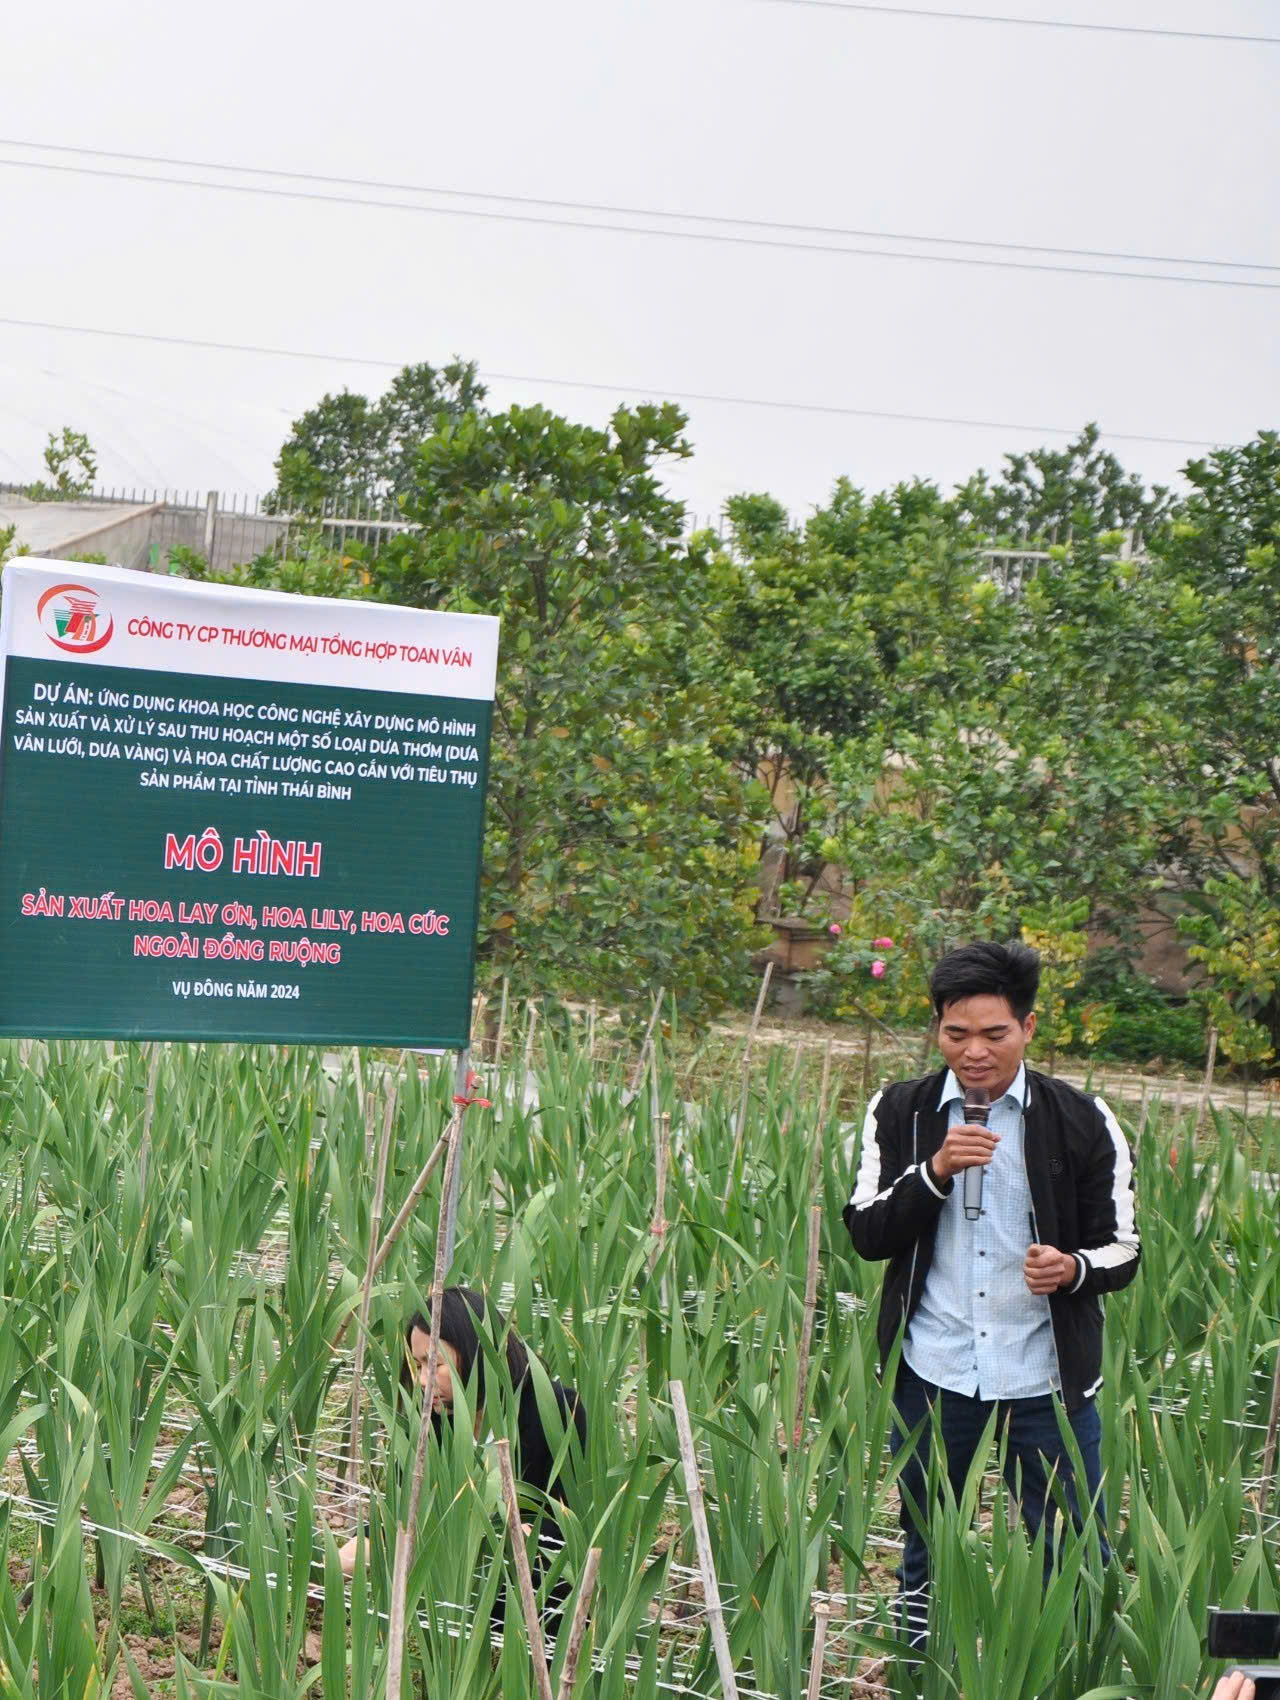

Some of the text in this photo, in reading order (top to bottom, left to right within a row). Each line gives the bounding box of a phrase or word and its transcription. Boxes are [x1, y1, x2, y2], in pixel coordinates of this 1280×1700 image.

[128, 616, 472, 668] CÔNG TY CP THƯƠNG MẠI TỔNG HỢP TOAN VÂN
[16, 706, 478, 762] SẢN XUẤT VÀ XỬ LÝ SAU THU HOẠCH MỘT SỐ LOẠI DƯA THƠM (DƯA
[34, 682, 476, 737] DỰ ÁN: ỨNG DỤNG KHOA HỌC CÔNG NGHỆ XÂY DỰNG MÔ HÌNH
[14, 733, 477, 788] VÂN LƯỚI, DƯA VÀNG) VÀ HOA CHẤT LƯỢNG CAO GẮN VỚI TIÊU THỤ
[140, 768, 352, 800] SẢN PHẨM TẠI TỈNH THÁI BÌNH
[164, 827, 322, 877] MÔ HÌNH
[21, 887, 450, 936] SẢN XUẤT HOA LAY ƠN, HOA LILY, HOA CÚC
[133, 931, 341, 968] NGOÀI ĐỒNG RUỘNG
[172, 978, 300, 999] VỤ ĐÔNG NĂM 2024
